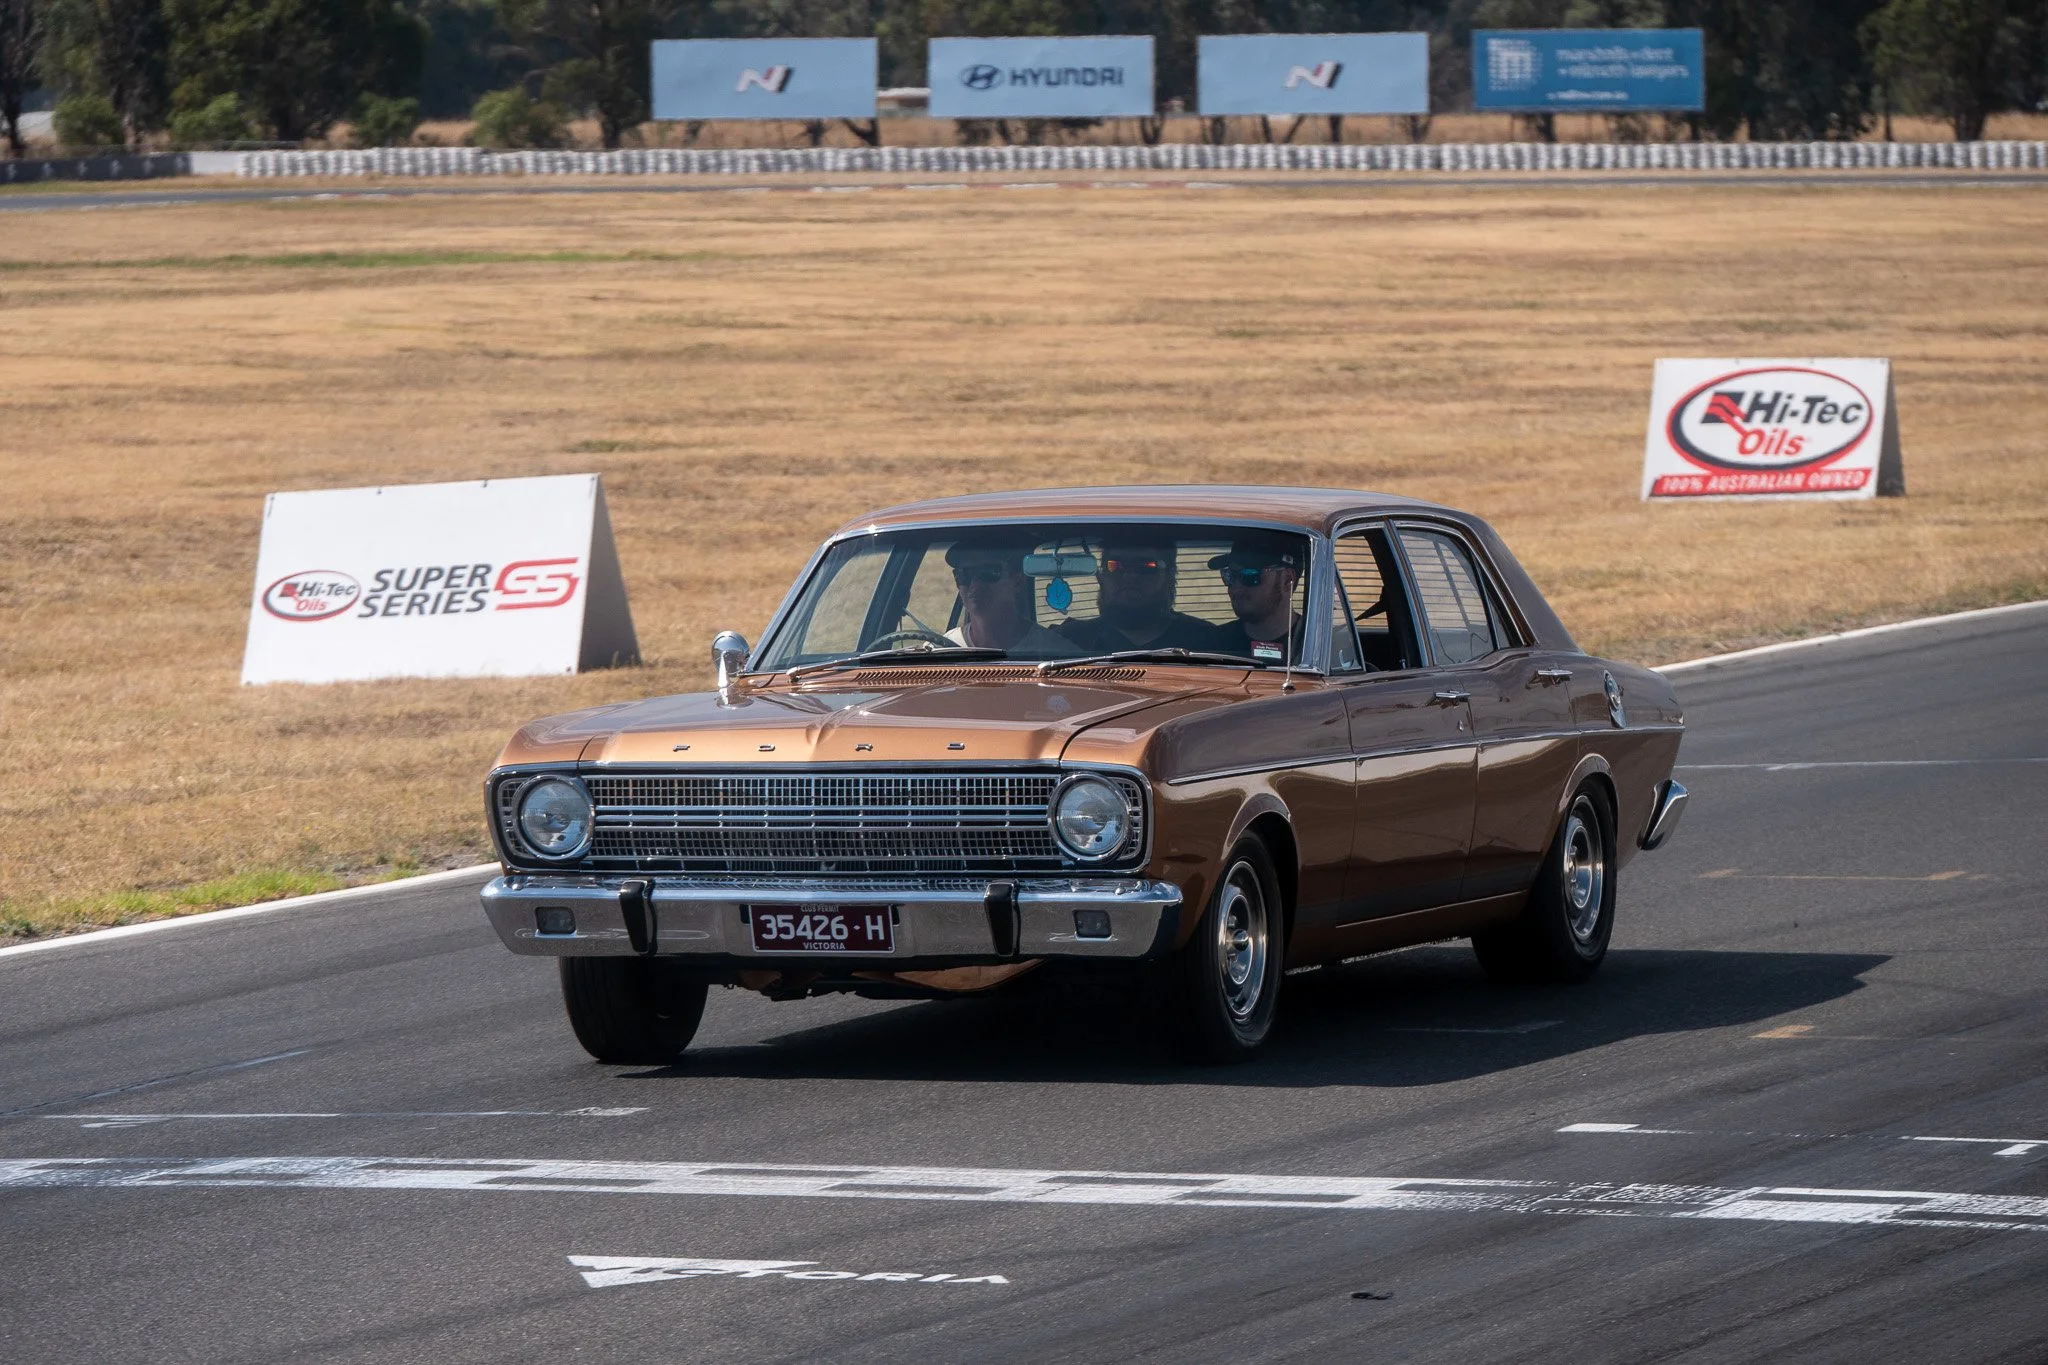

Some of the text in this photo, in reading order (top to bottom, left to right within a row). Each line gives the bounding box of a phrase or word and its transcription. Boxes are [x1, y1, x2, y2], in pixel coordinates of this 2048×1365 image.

[1009, 67, 1124, 86] HYUNDAI
[1742, 391, 1864, 424] Hi-Tec
[1737, 428, 1807, 456] Oils
[1662, 471, 1866, 492] 100% AUSTRALIAN OWNED
[300, 581, 358, 597] Hi-Tec
[370, 564, 493, 594] SUPER
[294, 600, 329, 612] Oils
[357, 589, 491, 619] SERIES
[803, 942, 846, 950] VICTORIA
